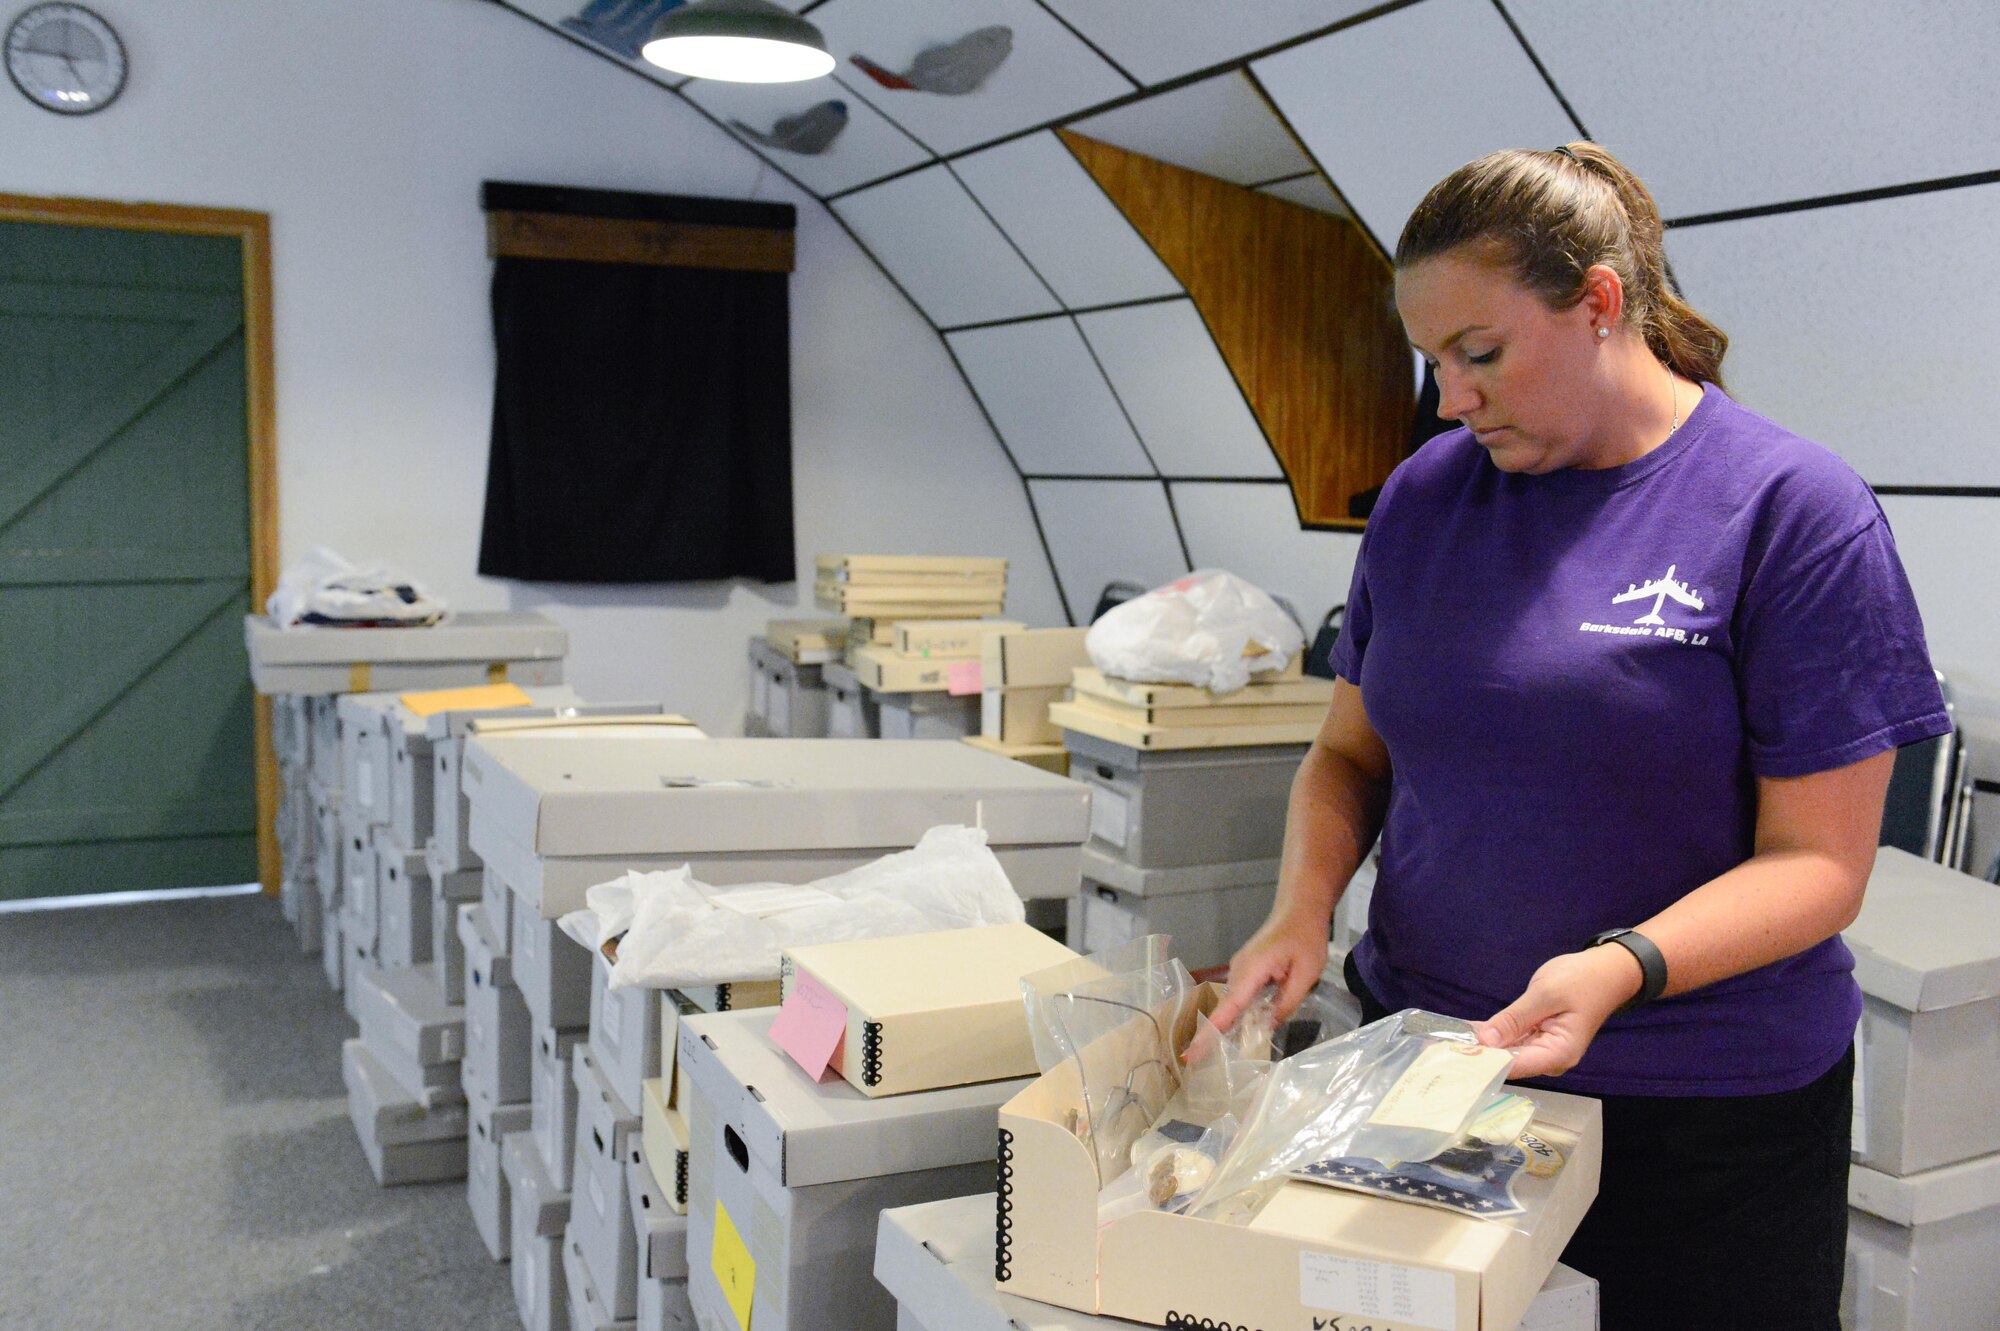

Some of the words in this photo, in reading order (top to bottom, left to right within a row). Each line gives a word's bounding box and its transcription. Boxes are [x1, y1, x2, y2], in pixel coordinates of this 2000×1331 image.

[1580, 622, 1652, 636] Barksdale
[1654, 627, 1688, 644] AFB,
[1690, 633, 1709, 646] LA
